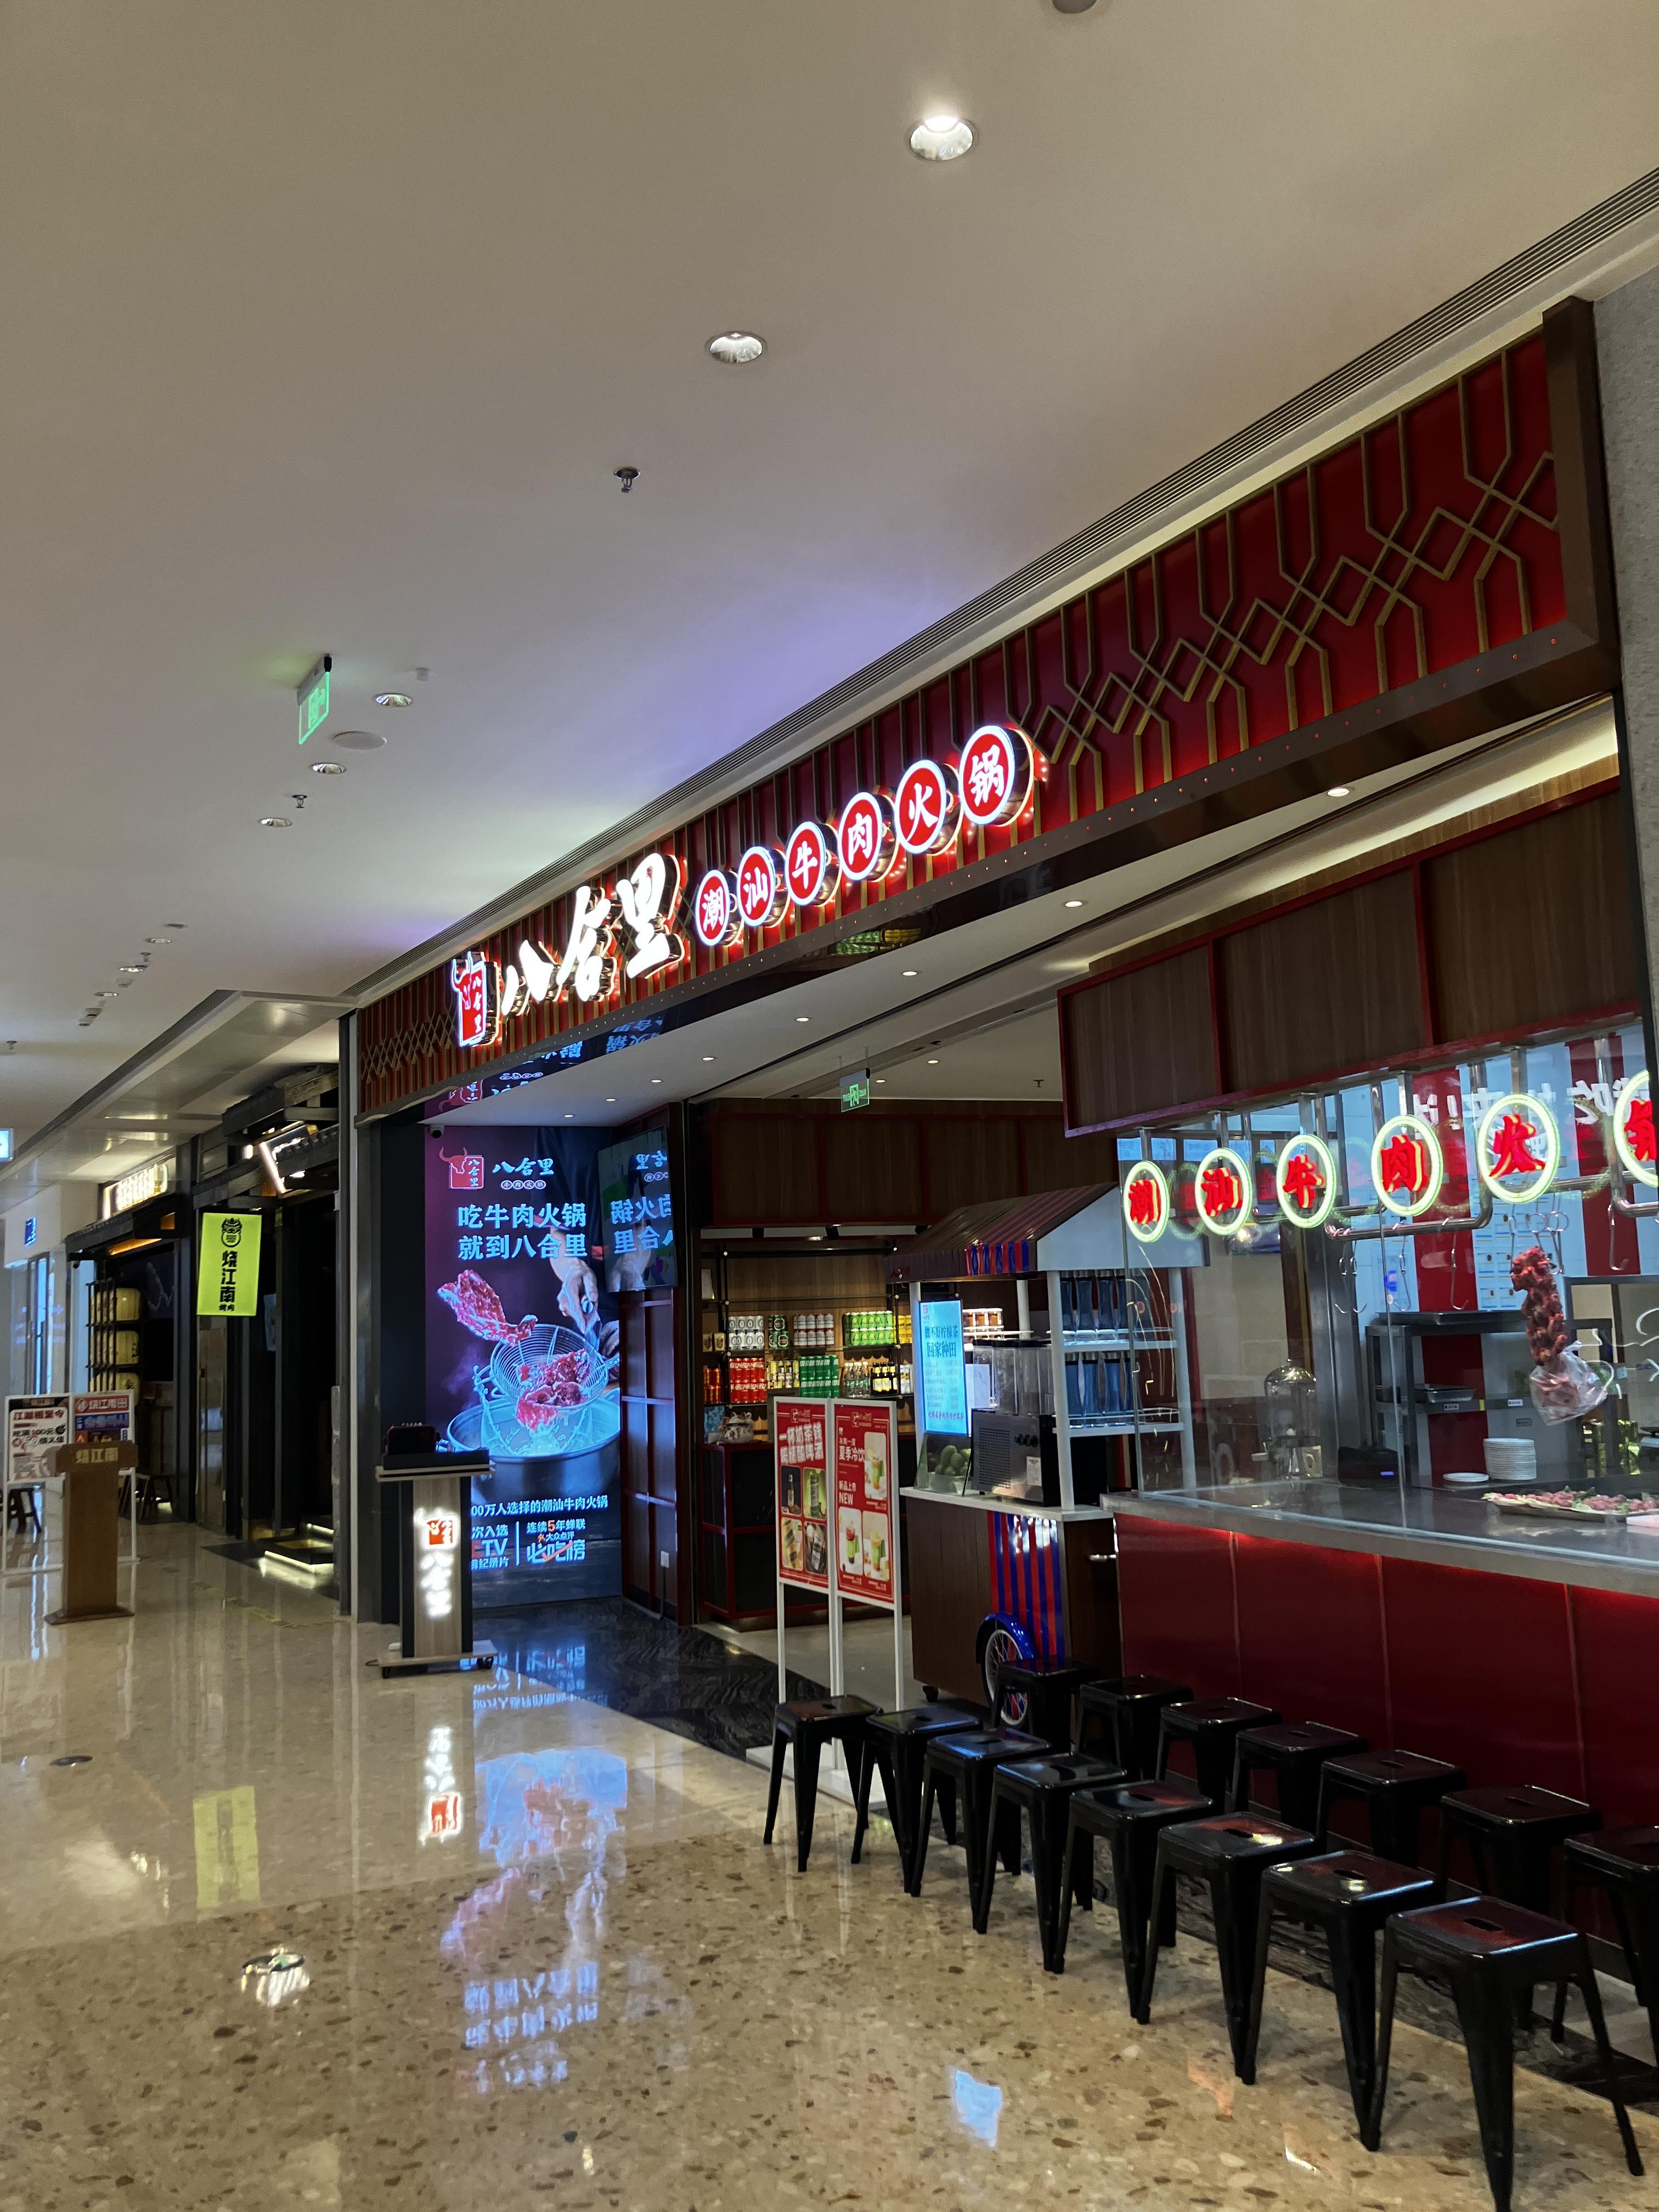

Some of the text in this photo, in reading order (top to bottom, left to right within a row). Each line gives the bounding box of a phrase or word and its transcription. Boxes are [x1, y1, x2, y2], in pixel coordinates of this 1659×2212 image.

[701, 743, 1006, 933] 潮汕牛肉火锅
[468, 1159, 481, 1187] 八合里
[492, 1157, 555, 1176] 八合里
[458, 1203, 587, 1229] 吃牛肉火锅
[458, 1233, 588, 1260] 就到八合里
[219, 1250, 238, 1302] 烧江南
[924, 1325, 958, 1339] 做不好柠檬茶
[927, 1341, 957, 1358] 回家种田
[778, 1421, 822, 1446] 一杯奶茶钱
[838, 1445, 865, 1462] 夏季冷饮
[838, 1491, 854, 1505] NEW
[526, 1518, 586, 1534] 连续5年蝉联
[545, 1531, 575, 1542] 大众点评
[526, 1539, 586, 1564] 必吃榜
